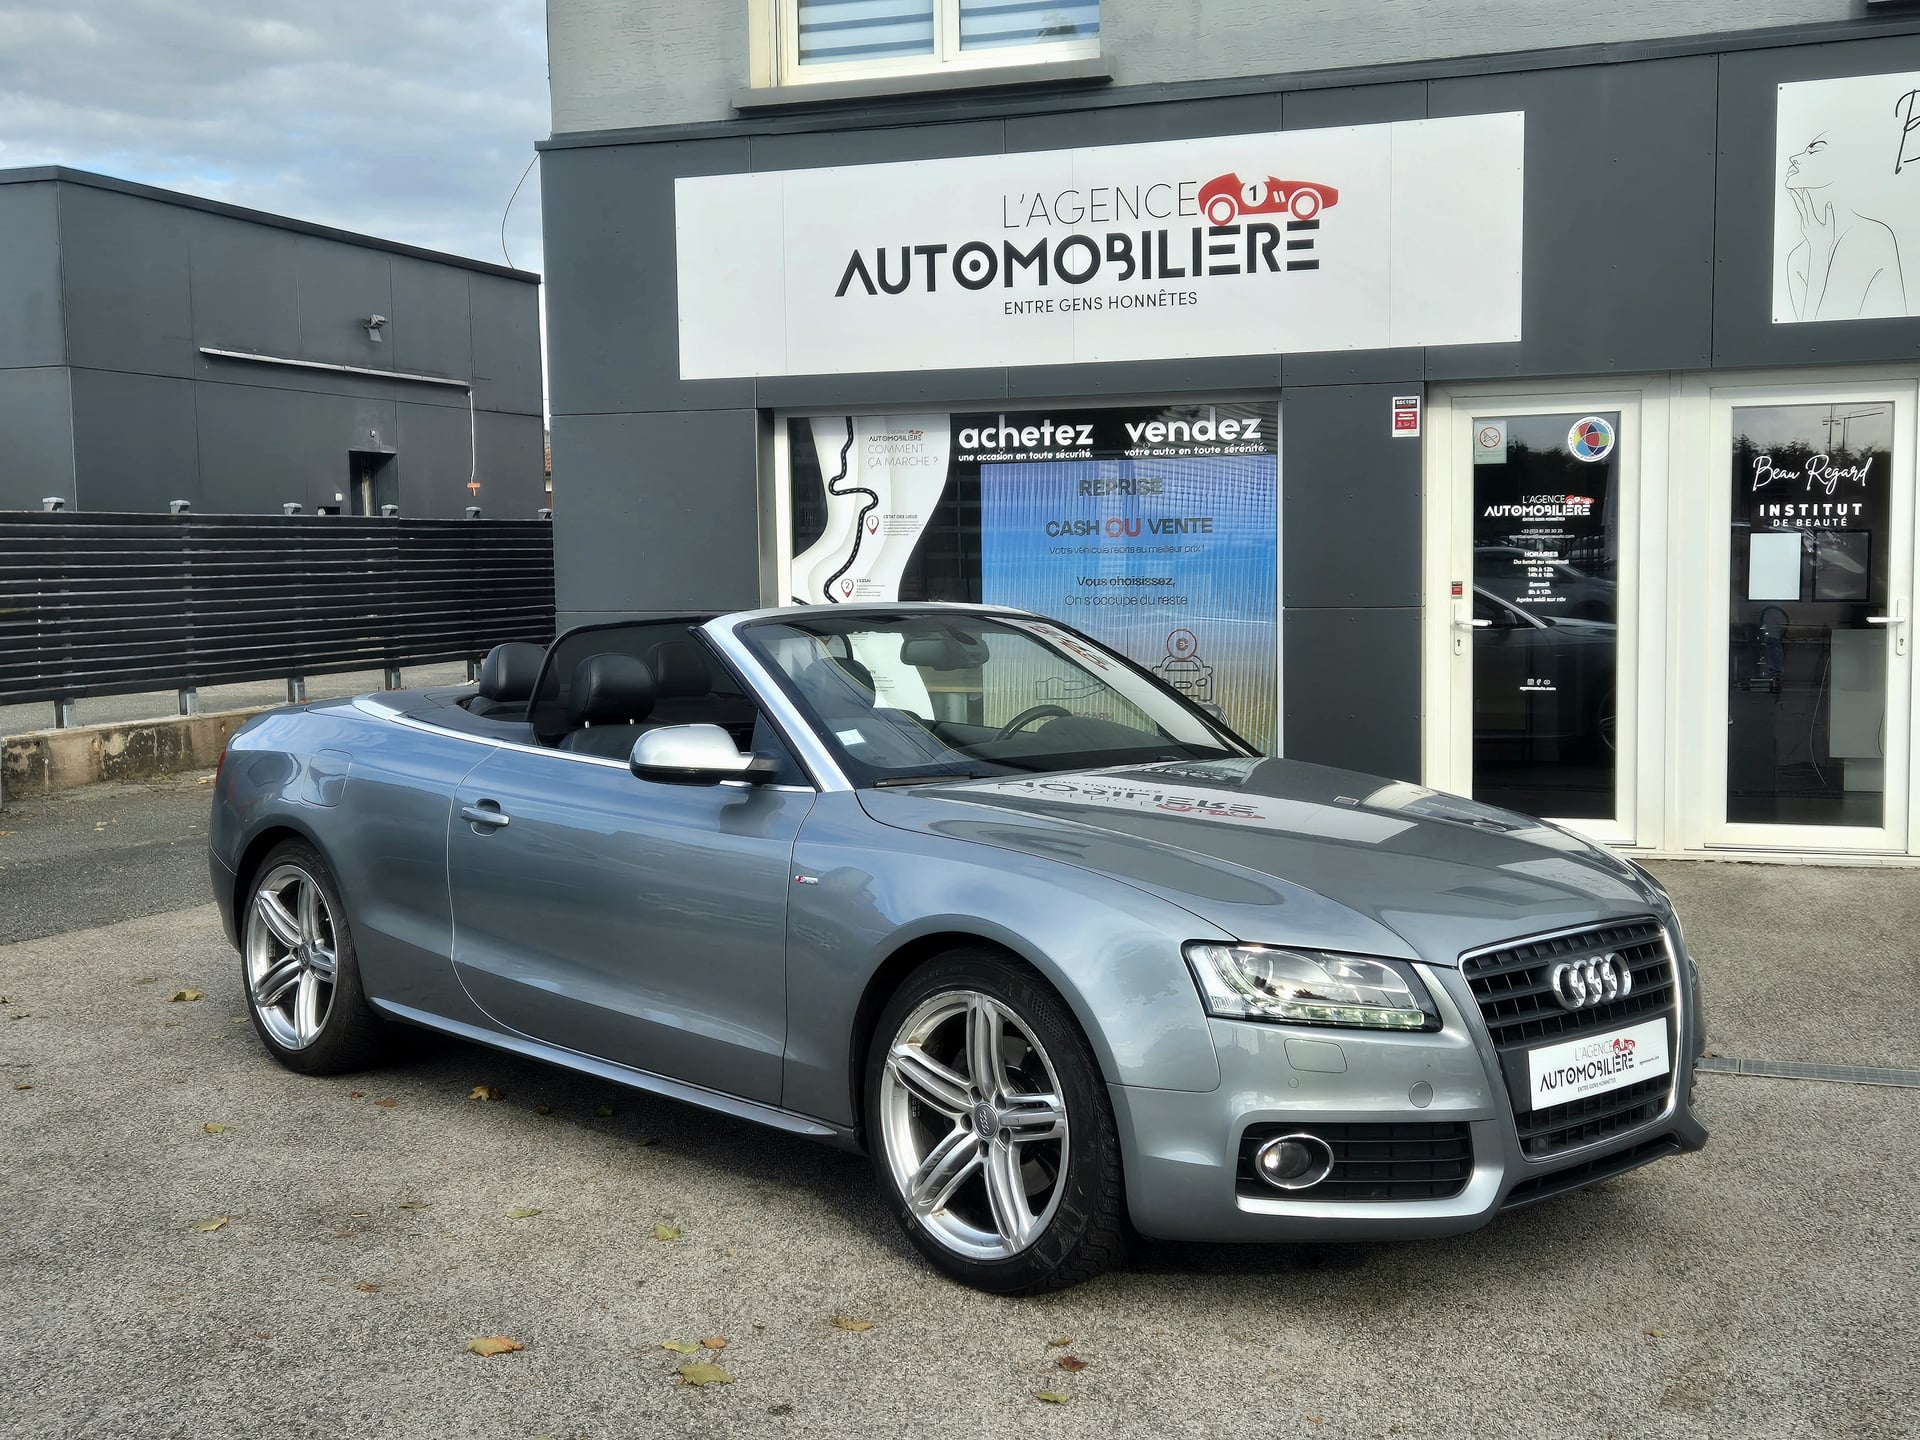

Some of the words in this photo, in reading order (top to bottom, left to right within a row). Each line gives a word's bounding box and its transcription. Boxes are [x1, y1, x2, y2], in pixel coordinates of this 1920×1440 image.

[1003, 181, 1198, 229] L'AGENCE
[834, 219, 1320, 297] AUTOMOBILIERE
[1004, 299, 1054, 315] ENTRE
[1058, 296, 1103, 312] GENS
[1108, 289, 1198, 310] HONNÊTES
[958, 414, 1094, 449] achetez
[1124, 406, 1262, 443] vendez
[867, 443, 925, 455] COMMENT
[976, 451, 1013, 461] occasion
[1016, 451, 1027, 460] en
[1029, 450, 1053, 460] toute
[1055, 447, 1093, 459] sécurité.
[1124, 447, 1150, 457] votre
[1152, 446, 1176, 456] auto
[1178, 446, 1191, 455] en
[1193, 444, 1221, 455] toute
[1224, 442, 1267, 454] sérénité.
[867, 457, 882, 469] ÇA
[885, 455, 929, 467] MARCHE
[1752, 455, 1800, 491] Beau
[1805, 454, 1873, 495] Regard
[1078, 477, 1164, 497] REPRISE
[1522, 494, 1565, 504] L'AGENCE
[1760, 503, 1863, 517] INSTITUT
[1045, 519, 1100, 537] CASH
[1105, 517, 1141, 538] OU
[1147, 517, 1213, 535] VENTE
[1773, 518, 1789, 527] DE
[1796, 516, 1848, 527] BEAUTÉ
[1049, 546, 1072, 555] Votre
[1074, 545, 1109, 555] véhicule
[1135, 546, 1148, 554] au
[1149, 544, 1184, 554] meilleur
[1184, 544, 1201, 556] prix
[1076, 576, 1107, 586] Vous
[1109, 575, 1176, 588] choisissez,
[1064, 594, 1081, 605] On
[1084, 594, 1138, 607] s'occupe
[1140, 594, 1155, 605] du
[1158, 594, 1188, 605] reste
[1574, 1039, 1614, 1062] L'AGENCE
[1539, 1051, 1635, 1092] AUTOMOBILIERE
